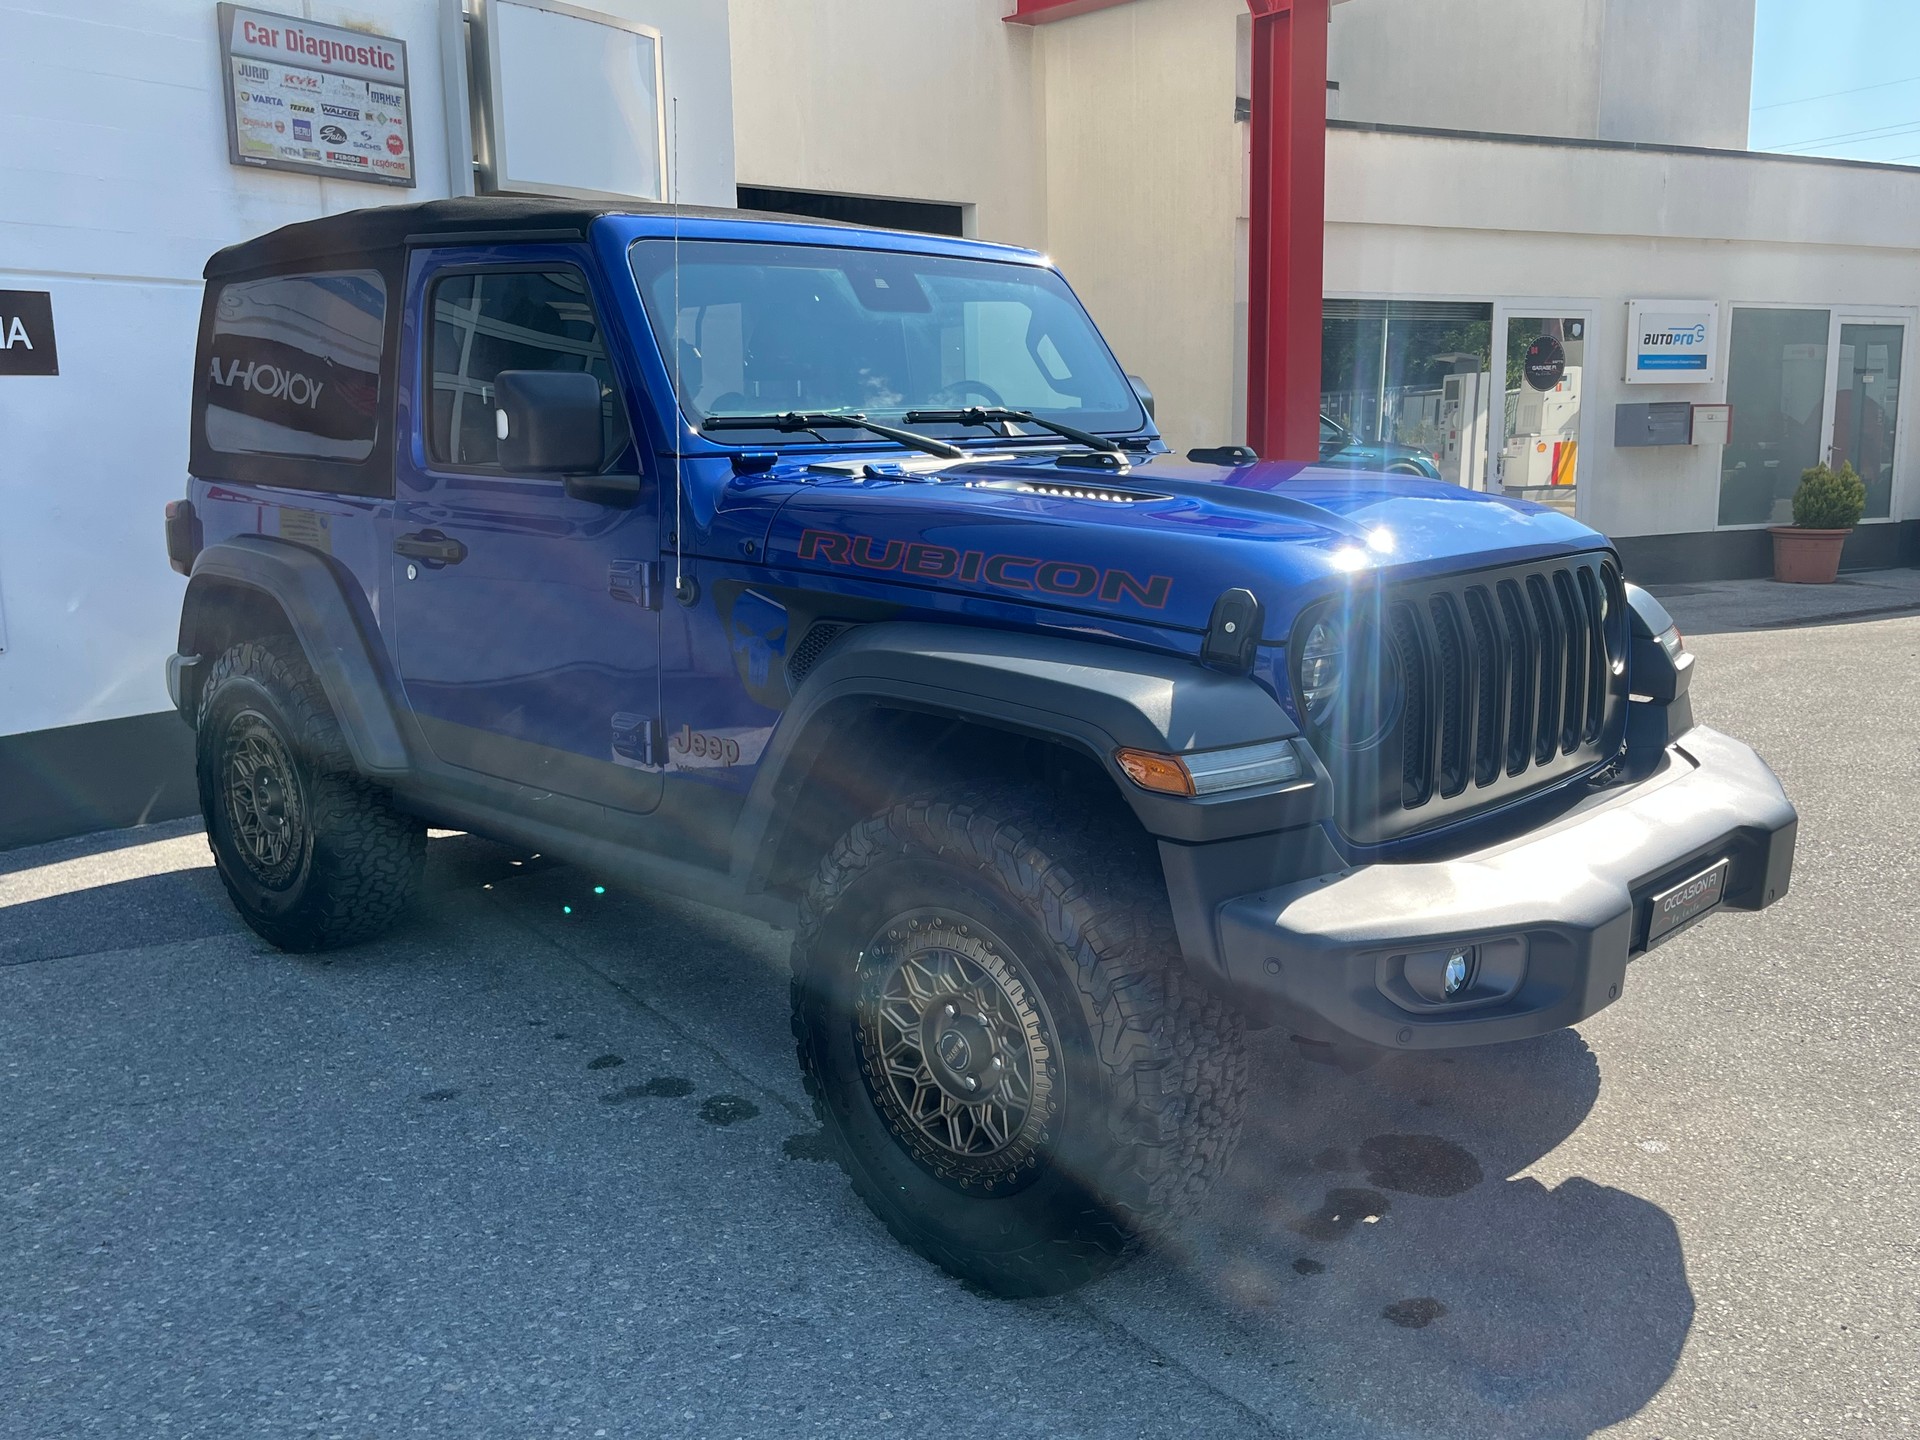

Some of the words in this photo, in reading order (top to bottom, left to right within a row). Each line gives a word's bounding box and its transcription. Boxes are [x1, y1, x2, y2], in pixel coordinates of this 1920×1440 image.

[243, 20, 280, 49] Car
[285, 28, 396, 72] Diagnostic
[251, 93, 284, 107] VARTA
[371, 91, 402, 104] MAHLE
[290, 103, 315, 114] TEXTAR
[321, 103, 360, 121] WALKER
[294, 126, 311, 137] BERU
[320, 126, 347, 143] Gates
[280, 146, 302, 157] NTN
[353, 141, 382, 151] SACHS
[334, 153, 361, 163] FERODO
[0, 316, 34, 350] A
[797, 528, 1173, 609] RUBICON
[674, 723, 740, 768] Jeep
[1664, 879, 1708, 912] OCCASION
